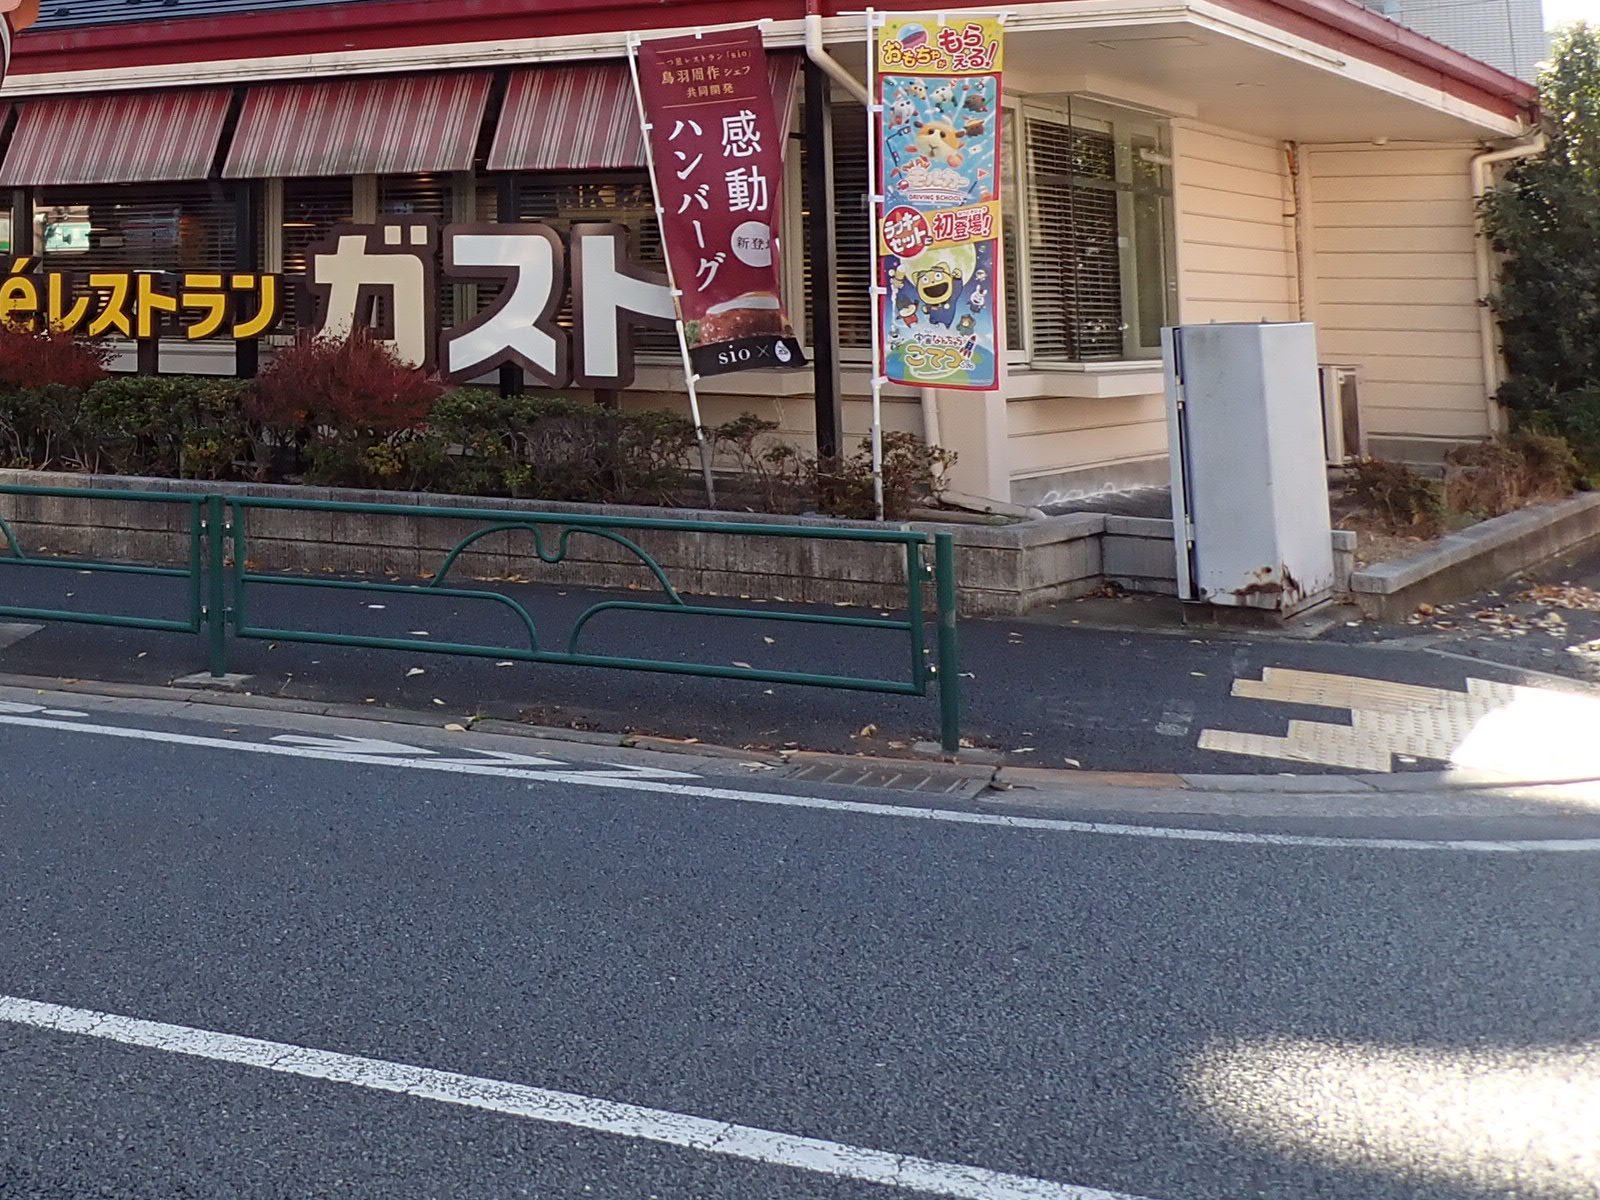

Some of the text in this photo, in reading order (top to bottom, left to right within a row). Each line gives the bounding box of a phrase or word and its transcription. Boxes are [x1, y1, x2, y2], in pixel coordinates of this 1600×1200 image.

[686, 83, 735, 99] 共同開発
[721, 109, 768, 212] 感動
[668, 120, 726, 292] ハンバーグ
[736, 236, 770, 250] 新登
[314, 225, 678, 377] ガスト
[718, 344, 750, 365] sio
